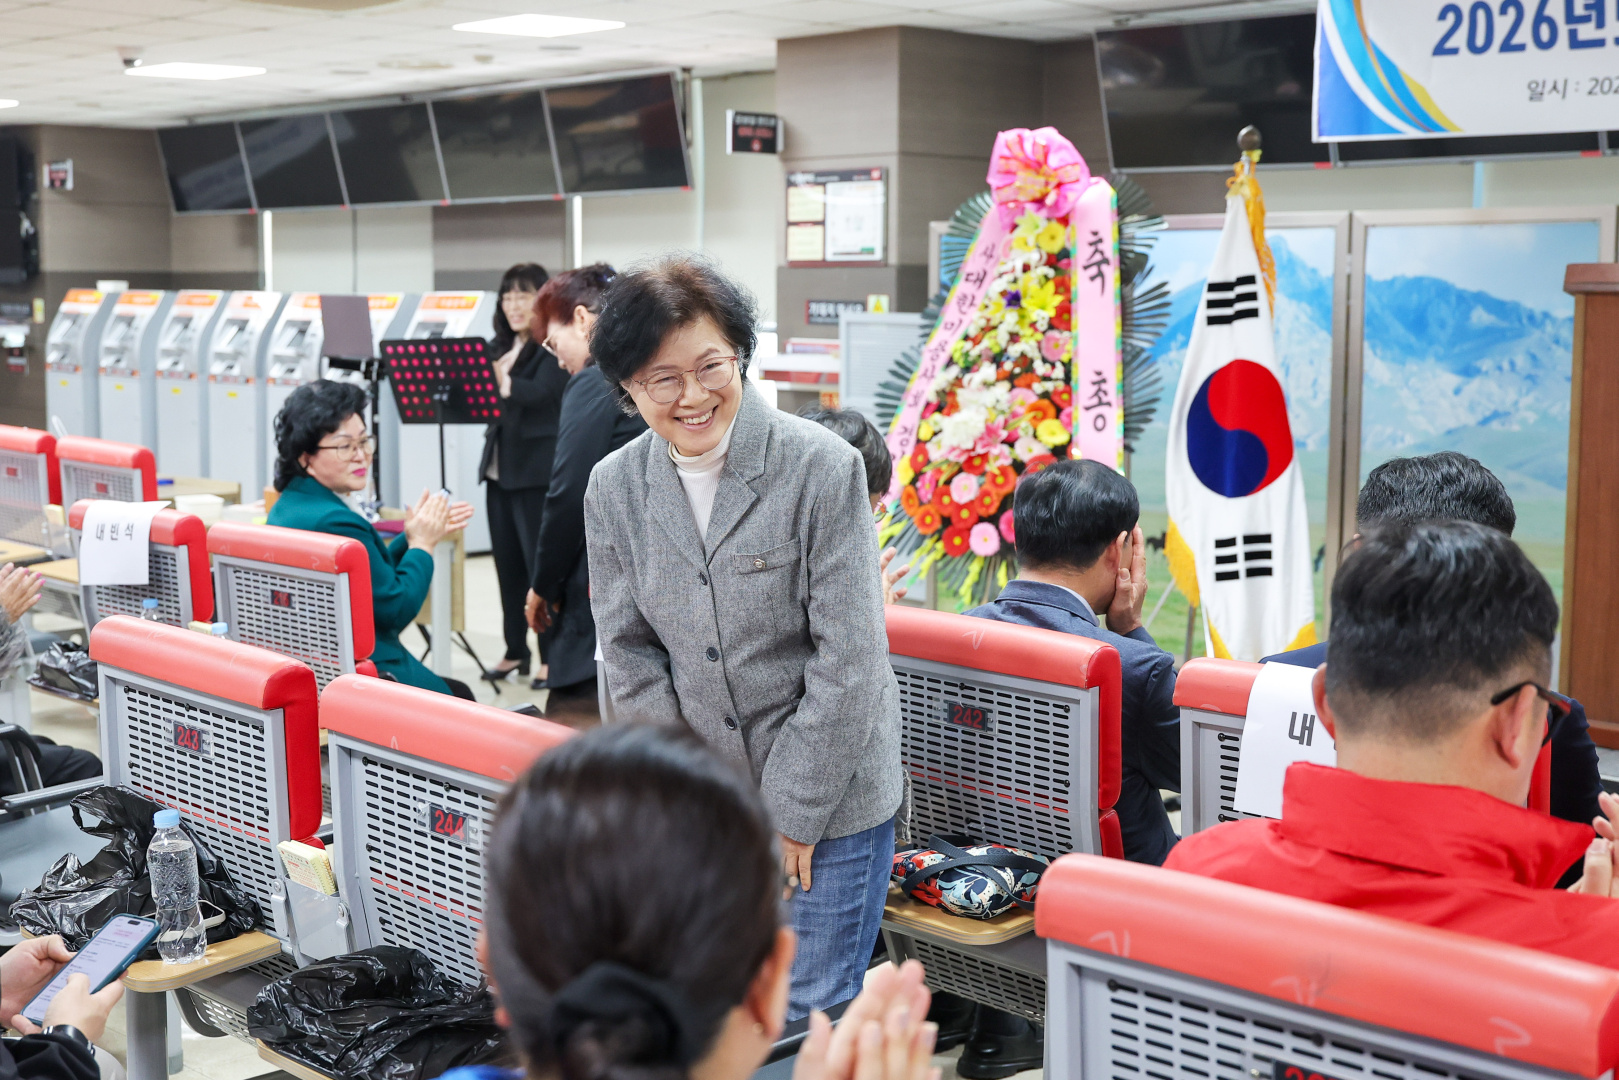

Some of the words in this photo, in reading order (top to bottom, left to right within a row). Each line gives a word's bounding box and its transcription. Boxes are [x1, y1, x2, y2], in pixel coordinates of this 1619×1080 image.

[1432, 0, 1619, 56] 2026년
[1527, 78, 1568, 102] 일시
[953, 704, 983, 729] 242
[177, 726, 199, 751] 243
[434, 810, 464, 840] 244
